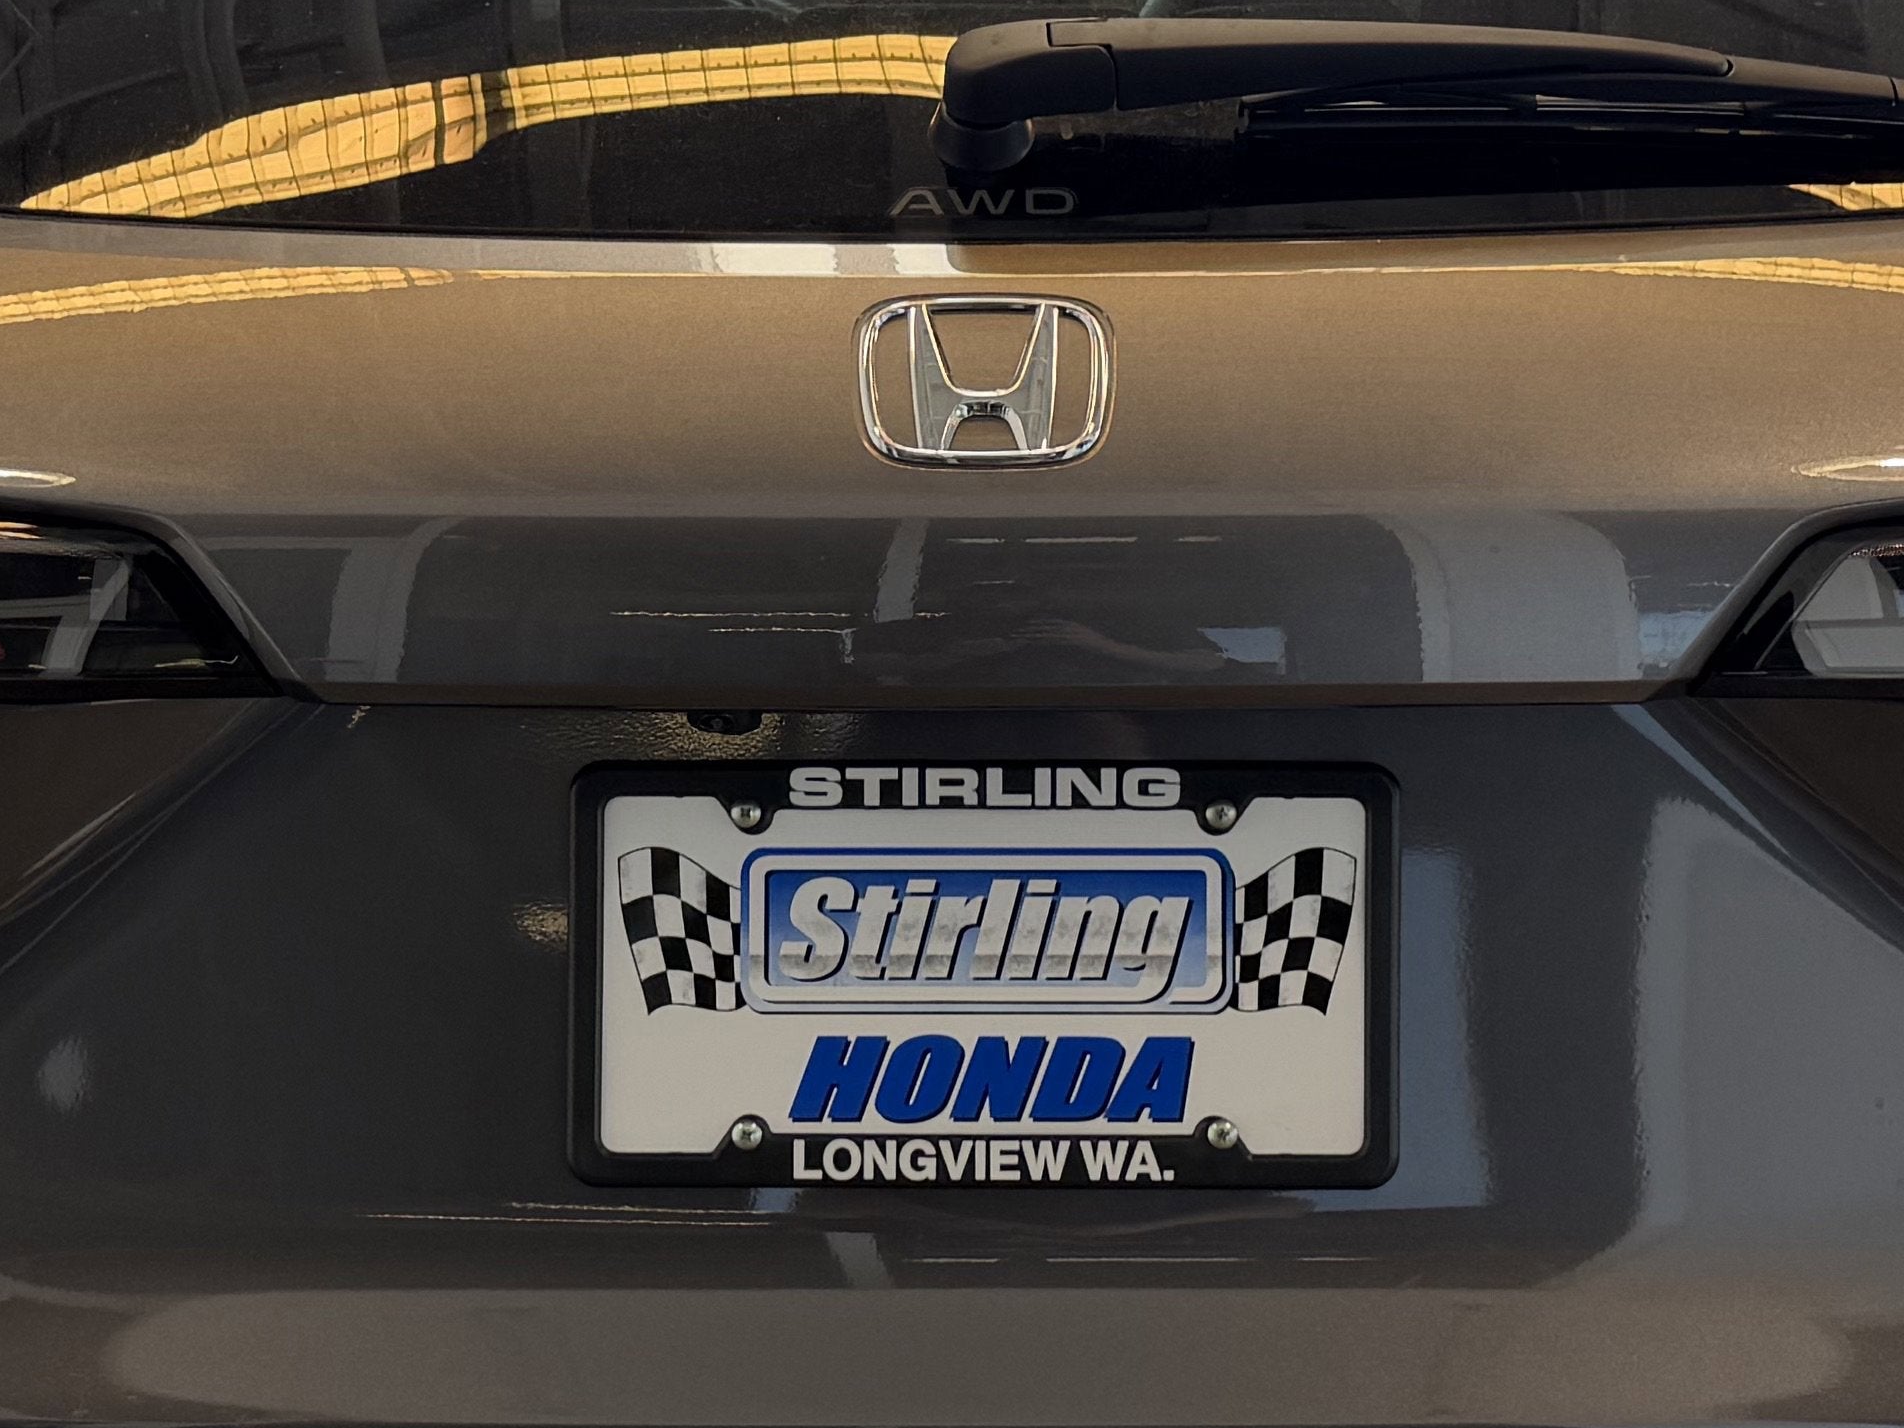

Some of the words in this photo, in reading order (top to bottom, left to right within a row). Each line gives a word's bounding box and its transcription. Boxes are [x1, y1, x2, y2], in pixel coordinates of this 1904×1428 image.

[889, 186, 1080, 217] AWD
[788, 766, 1182, 808] STIRLING
[779, 876, 1193, 1002] Stirling
[787, 1033, 1195, 1124] HONDA
[792, 1138, 1071, 1182] LONGVIEW
[1079, 1139, 1175, 1182] WA.
